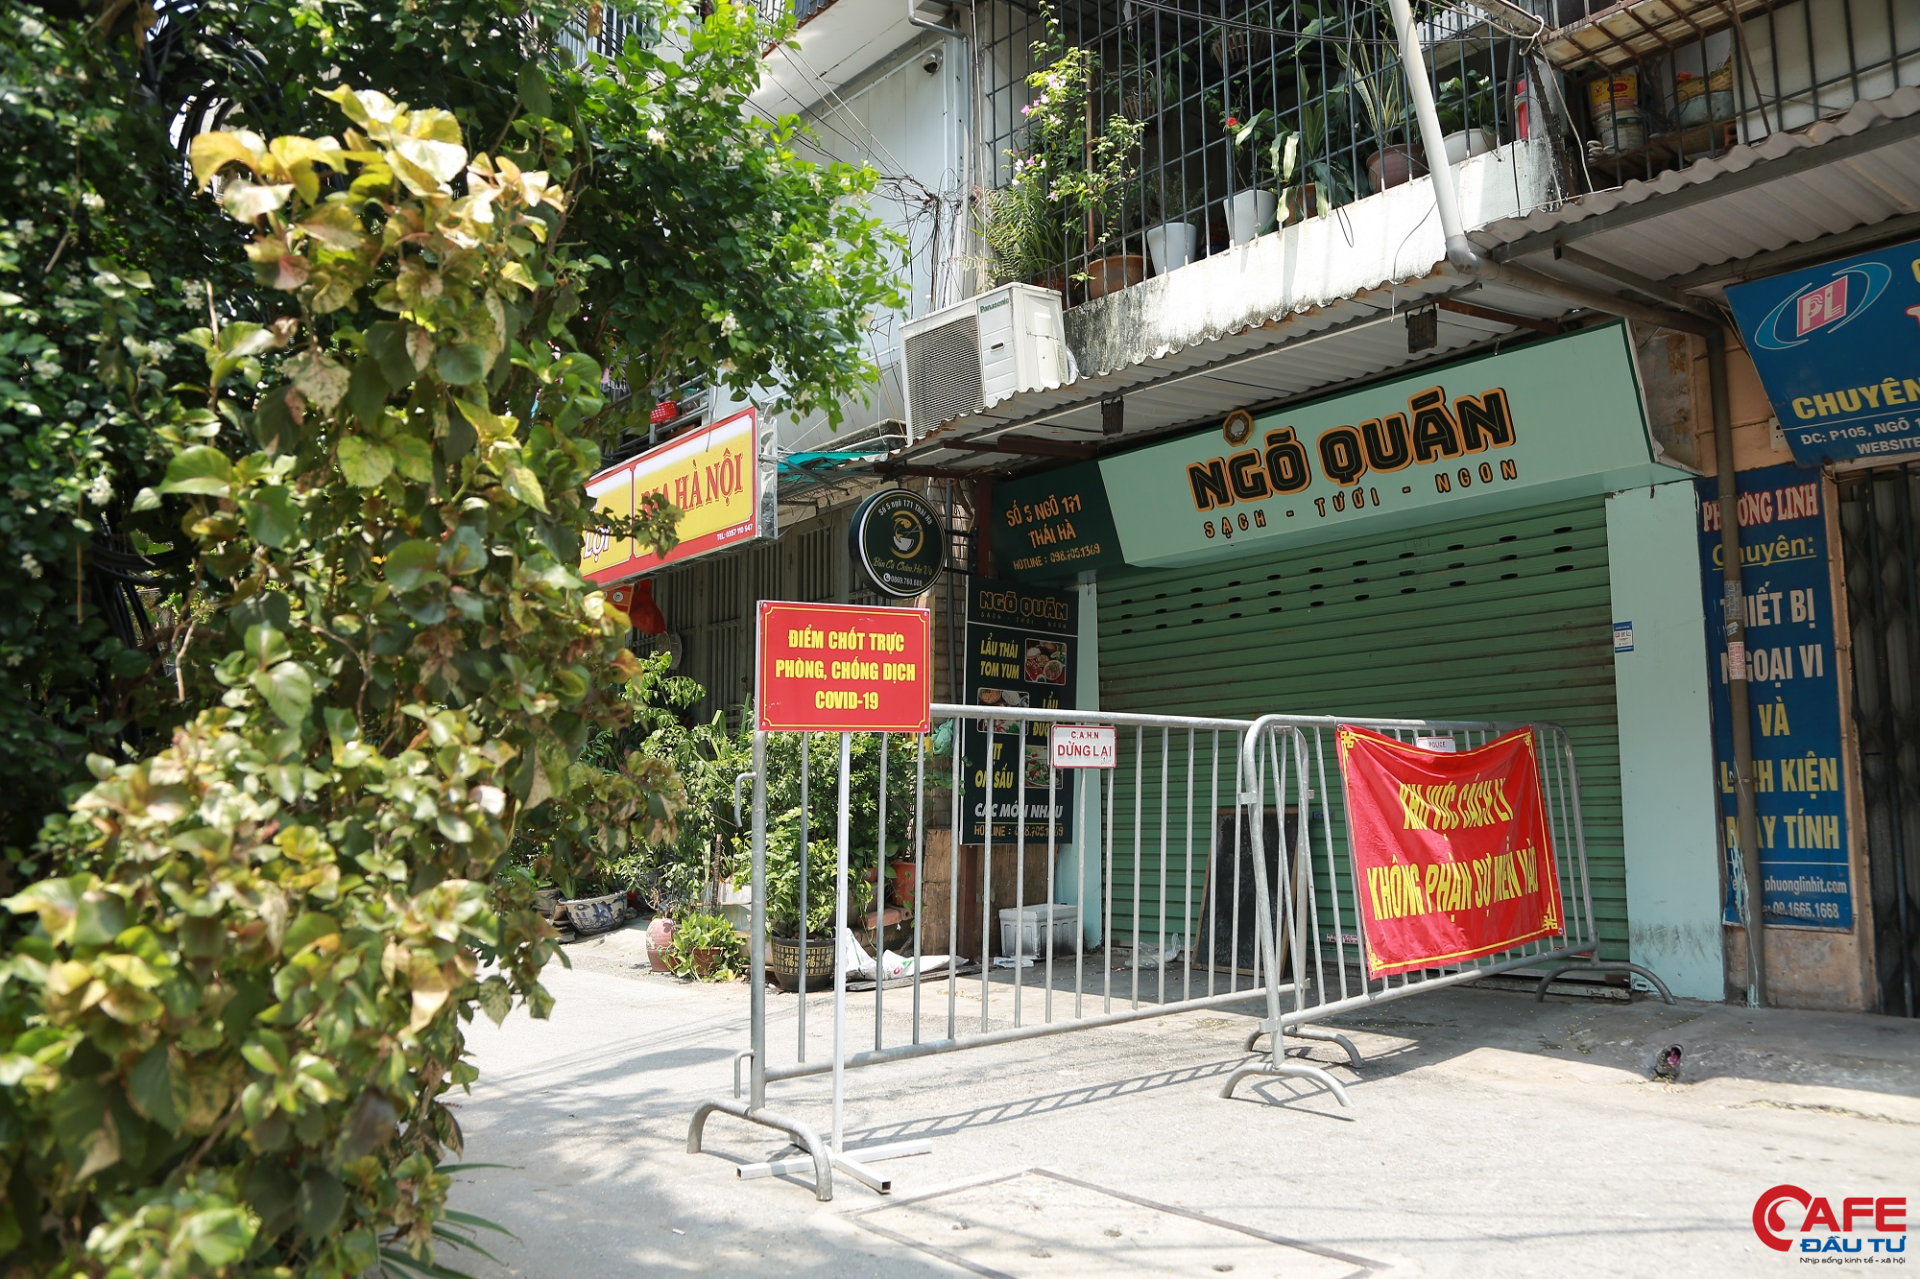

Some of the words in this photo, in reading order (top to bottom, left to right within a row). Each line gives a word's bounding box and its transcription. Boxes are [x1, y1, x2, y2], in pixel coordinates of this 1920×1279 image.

[980, 297, 1010, 313] Panasonic
[1801, 433, 1827, 445] ĐC:
[1829, 427, 1872, 440] P105,
[1874, 417, 1910, 434] NGÕ
[675, 459, 703, 511] HÀ
[705, 447, 743, 507] NỘI
[1186, 425, 1311, 513] NGÕ
[903, 499, 914, 509] 171
[1006, 500, 1022, 527] SỐ
[1023, 505, 1033, 522] 5
[1034, 494, 1060, 521] NGÕ
[1061, 494, 1082, 514] 171
[1204, 510, 1267, 539] SẠCH
[1314, 487, 1380, 517] TƯƠI
[1435, 458, 1517, 494] NGON
[1702, 490, 1773, 532] PHƠNG
[1775, 483, 1820, 521] LINH
[716, 532, 726, 541] TEL:
[1028, 523, 1057, 548] THÁI
[1057, 519, 1077, 540] HÀ
[1013, 556, 1044, 570] HOTLINE
[980, 590, 1018, 613] NGÕ
[1789, 587, 1816, 629] BỊ
[788, 623, 824, 649] ĐIỂM
[828, 626, 866, 650] CHỐT
[869, 631, 905, 654] TRỰC
[980, 632, 998, 656] LẨU
[999, 640, 1019, 659] THÁI
[775, 657, 828, 681] PHÒNG,
[831, 656, 879, 680] CHỐNG
[883, 663, 916, 684] DỊCH
[980, 661, 999, 678] TOM
[1001, 663, 1020, 680] YUM
[1799, 644, 1824, 678] VI
[815, 690, 879, 710] COVID-19
[1757, 695, 1791, 737] VÀ
[1058, 741, 1091, 757] DỪNG
[1093, 745, 1112, 760] LẠI
[993, 762, 1014, 789] SẤU
[1780, 751, 1838, 799] KIỆN
[1457, 773, 1496, 829] CÁCH
[1783, 808, 1840, 850] TÍNH
[1366, 853, 1425, 921] KHÔNG
[1472, 852, 1492, 917] SỰ
